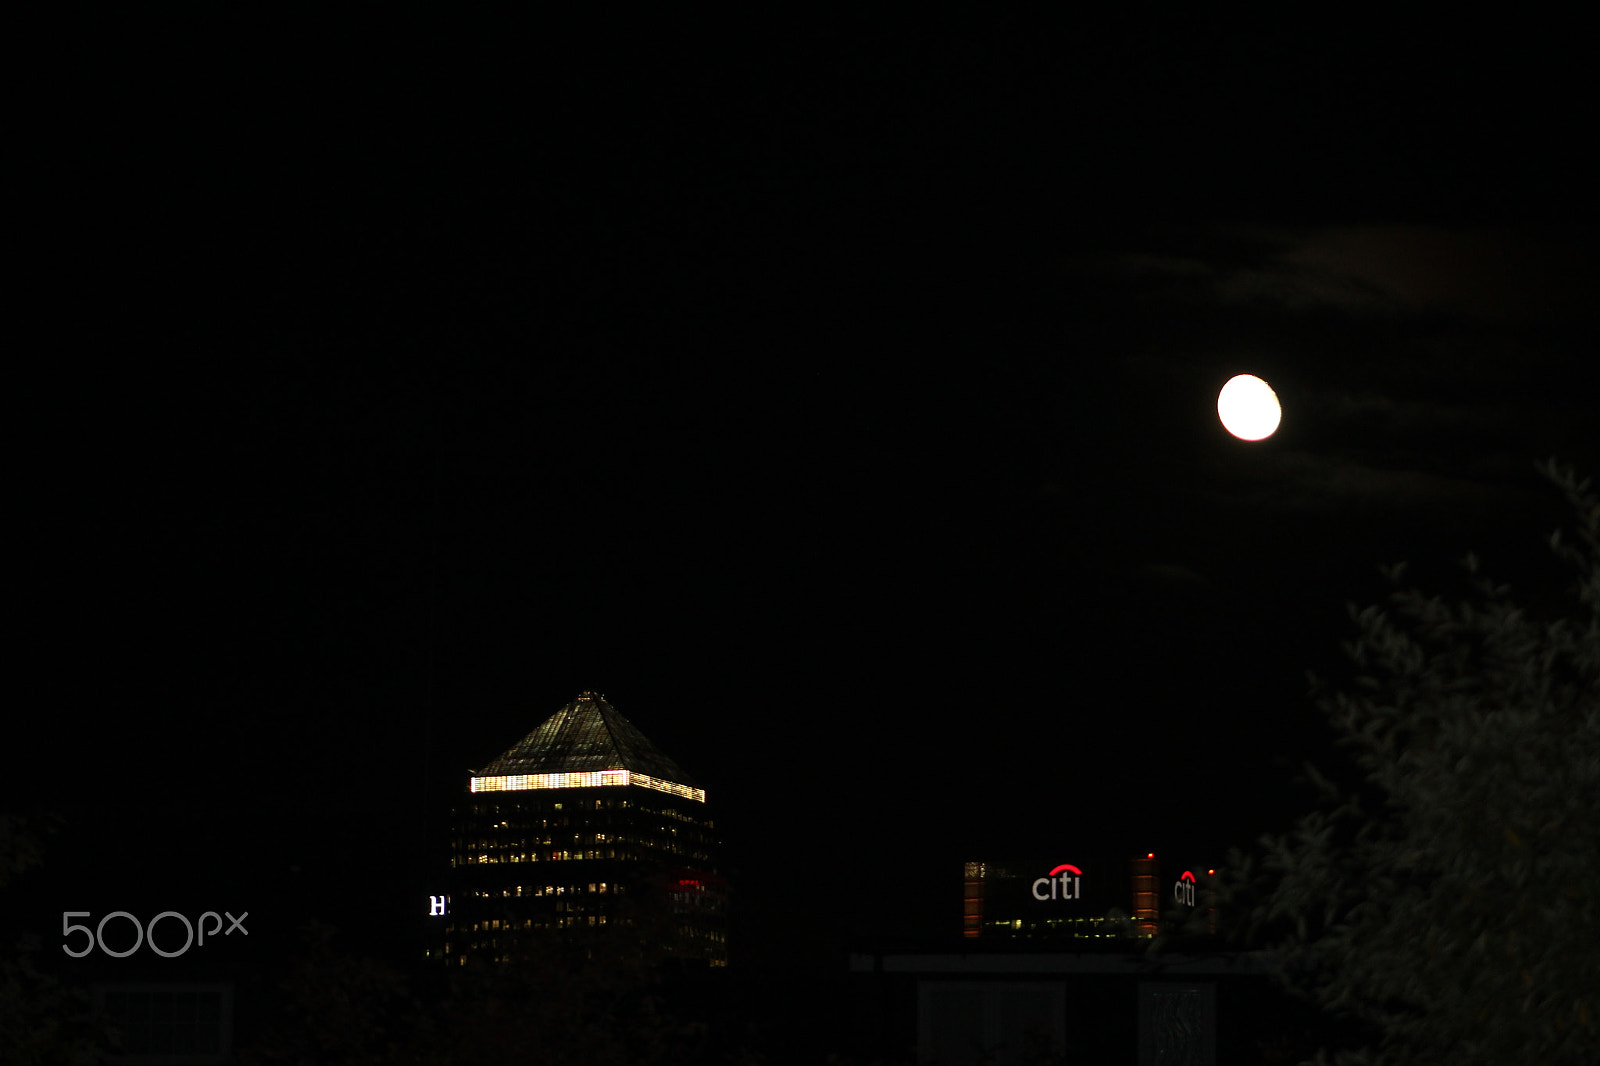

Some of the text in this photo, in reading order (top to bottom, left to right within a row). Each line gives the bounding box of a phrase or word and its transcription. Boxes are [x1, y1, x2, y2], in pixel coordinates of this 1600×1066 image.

[1031, 864, 1082, 901] citi
[1174, 871, 1196, 907] citi
[429, 895, 446, 916] H
